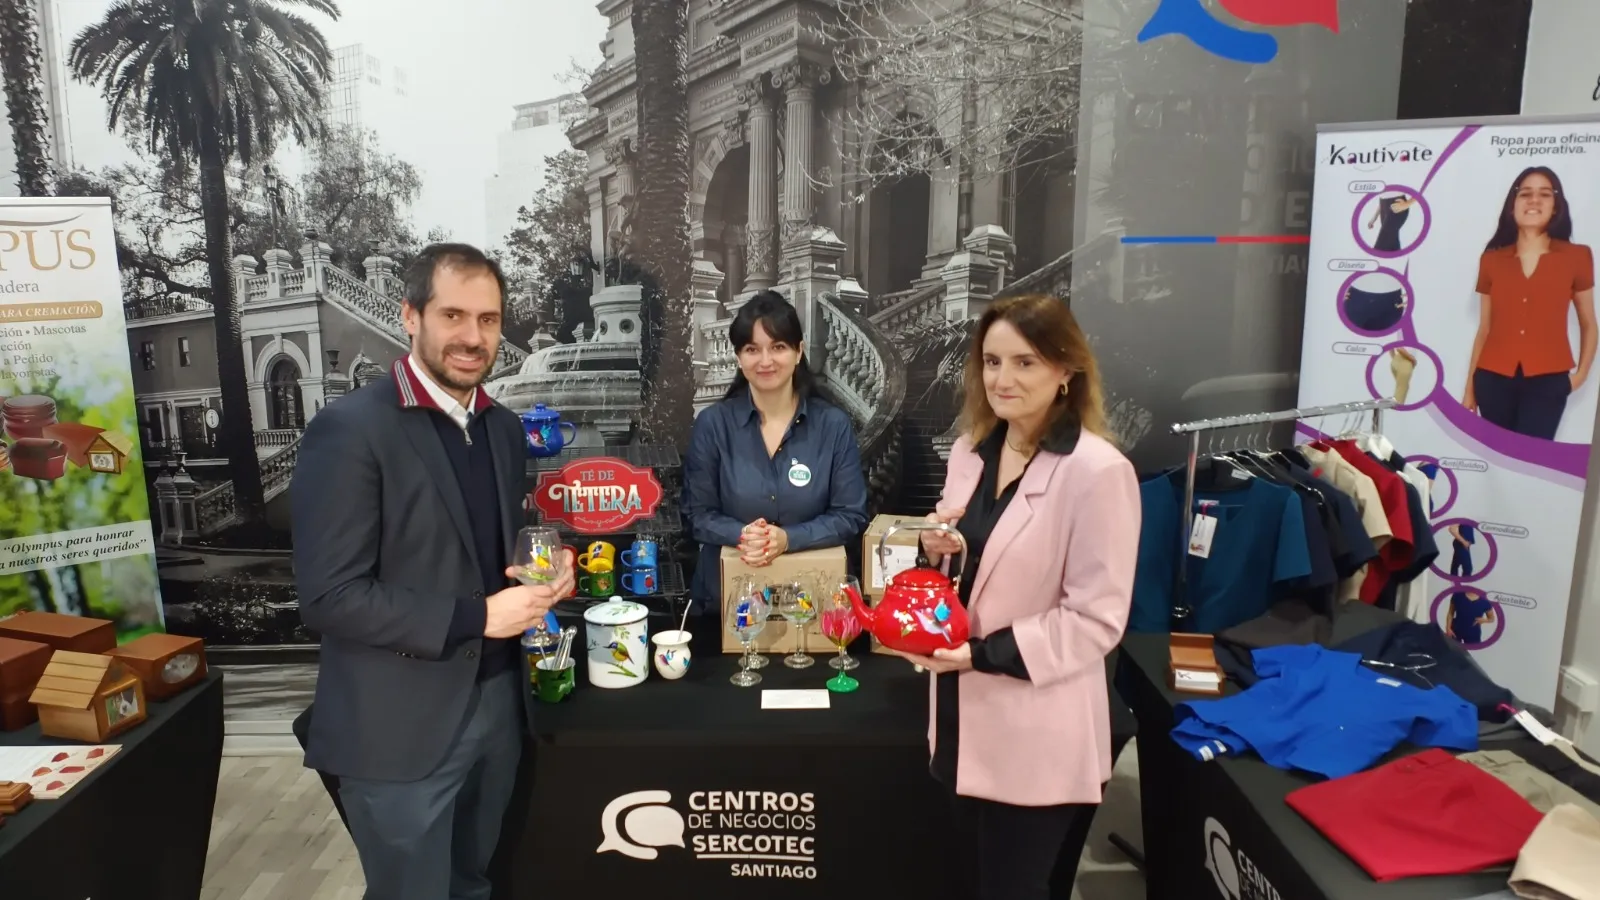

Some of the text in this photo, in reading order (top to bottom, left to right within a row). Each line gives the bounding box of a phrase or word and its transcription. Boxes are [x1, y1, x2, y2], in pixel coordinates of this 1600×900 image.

[1490, 135, 1524, 147] Ropa
[1526, 136, 1557, 146] para
[1330, 144, 1433, 165] Kautivate
[1497, 144, 1587, 158] y corporativa.
[25, 303, 97, 317] CREMACIÓN
[33, 325, 87, 336] Mascotas
[13, 353, 53, 365] Pedido
[598, 470, 615, 480] DE
[548, 480, 642, 514] TETERA
[66, 536, 92, 549] para
[96, 529, 134, 542] honrar
[9, 554, 58, 568] nuestros
[61, 550, 89, 560] seres
[688, 790, 815, 812] CENTROS
[688, 813, 816, 831] DE NEGOCIOS
[692, 834, 815, 855] SERCOTEC
[730, 863, 817, 879] SANTIAGO
